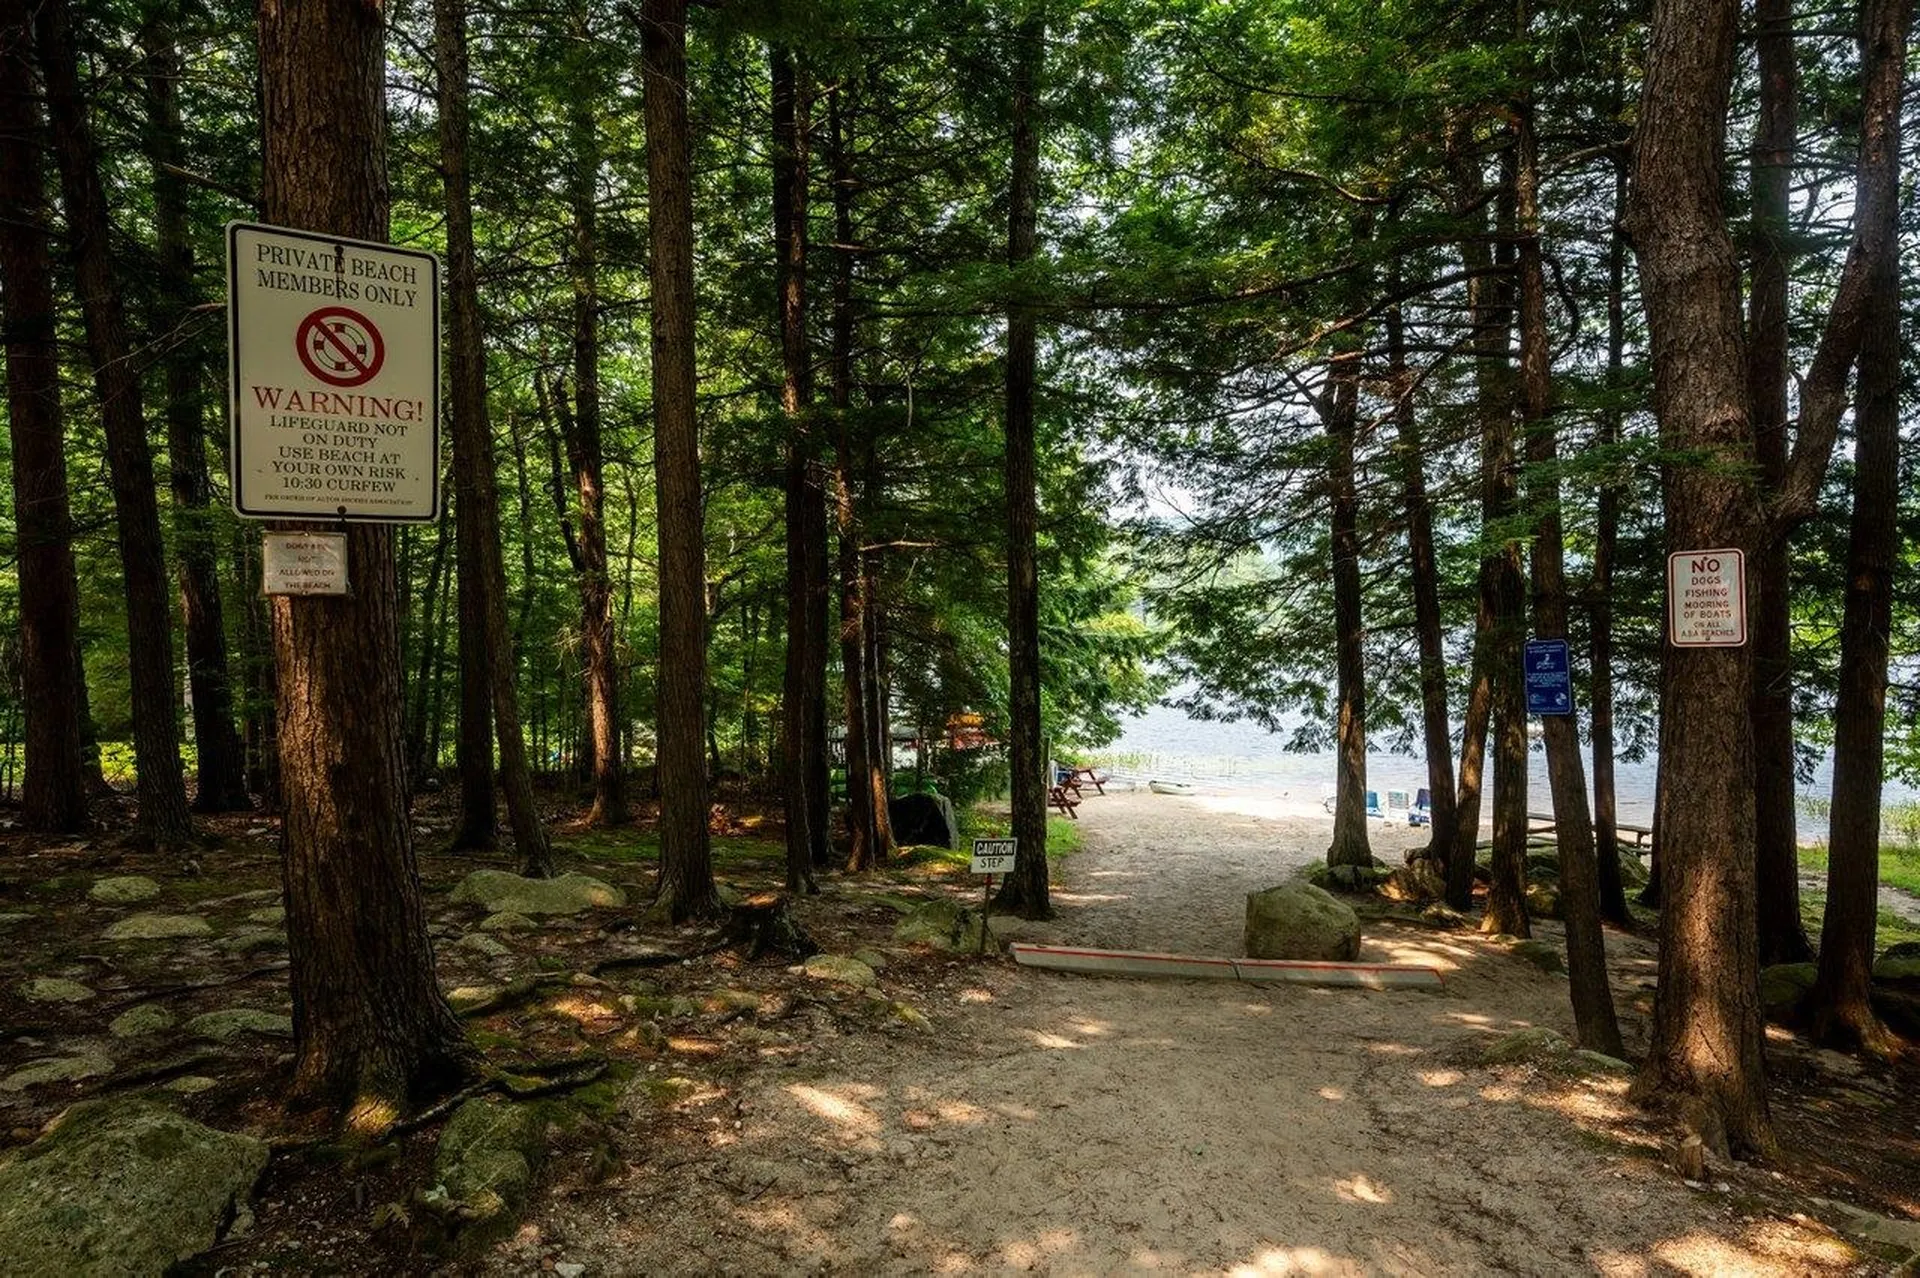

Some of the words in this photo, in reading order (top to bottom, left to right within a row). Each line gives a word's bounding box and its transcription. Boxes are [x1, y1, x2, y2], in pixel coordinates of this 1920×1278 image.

[256, 244, 345, 274] PRIVATE
[351, 258, 417, 285] BEACH
[257, 269, 359, 300] MEMBERS
[365, 284, 417, 308] ONLY
[252, 386, 424, 422] WARNING!
[270, 415, 370, 434] LIFEGUARD
[374, 423, 408, 437] NOT
[303, 433, 328, 445] ON
[333, 434, 377, 449] DUTY
[279, 446, 314, 460] USE
[319, 448, 375, 464] BEACH
[379, 453, 401, 465] AT
[272, 460, 320, 475] YOUR
[325, 463, 363, 477] OWN
[369, 466, 406, 480] RISK
[283, 477, 322, 490] 10:30
[326, 478, 396, 493] CURFEW
[279, 569, 320, 577] ALLOWED
[1691, 559, 1720, 574] NO
[1691, 576, 1721, 586] DOGS
[1685, 588, 1728, 598] FISHING
[1684, 601, 1729, 610] MOORING
[1683, 611, 1695, 619] OF
[1700, 610, 1732, 619] BOATS
[1701, 629, 1735, 637] BEACHES
[976, 842, 1014, 855] CAUTION
[980, 857, 1005, 868] STEP
